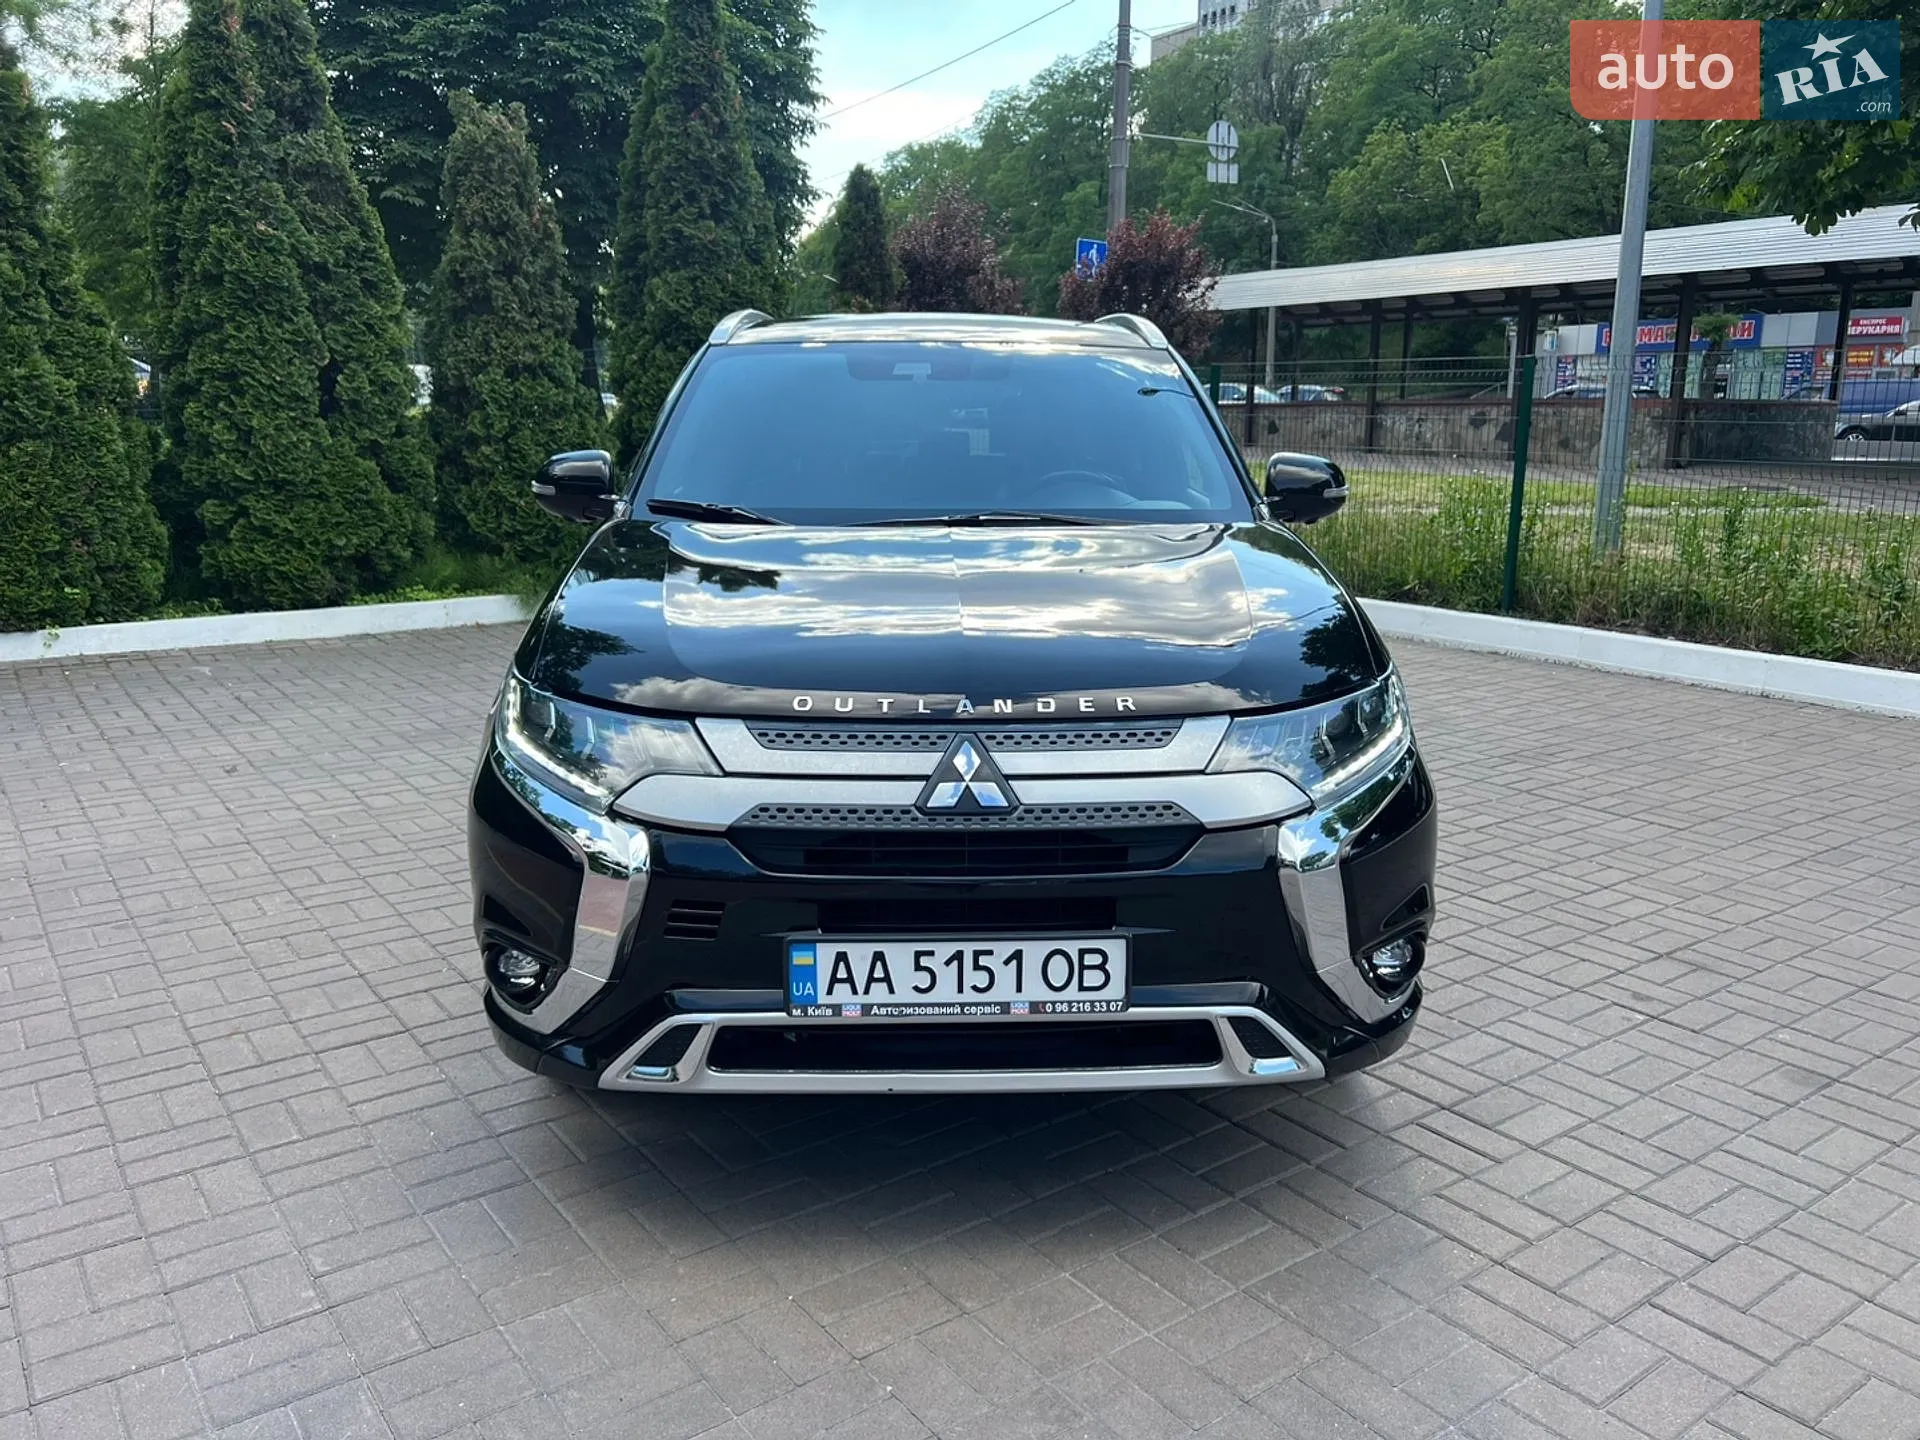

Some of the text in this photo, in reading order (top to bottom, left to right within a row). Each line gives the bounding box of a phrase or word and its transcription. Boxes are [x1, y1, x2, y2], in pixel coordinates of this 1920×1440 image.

[792, 695, 1137, 714] OUTLANDER
[825, 947, 1111, 996] AA 5151 OB
[792, 982, 815, 997] UA
[807, 1006, 833, 1016] Київ
[963, 1004, 1001, 1016] сервіс
[1045, 1003, 1052, 1012] 0
[1071, 1002, 1090, 1012] 216
[1093, 1002, 1107, 1011] 33
[1109, 1001, 1123, 1011] 07
